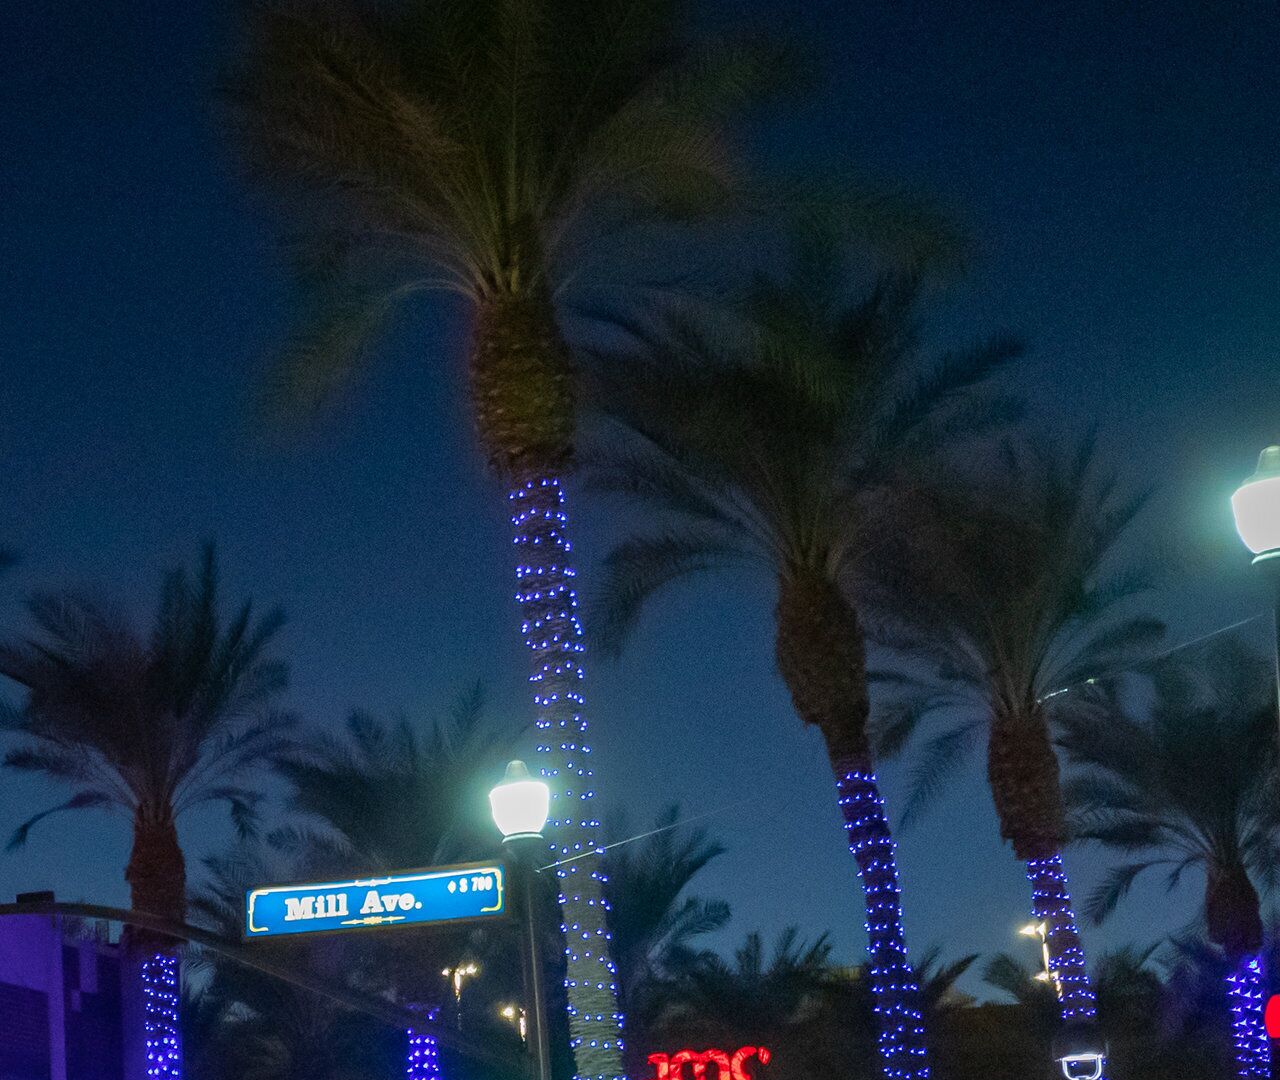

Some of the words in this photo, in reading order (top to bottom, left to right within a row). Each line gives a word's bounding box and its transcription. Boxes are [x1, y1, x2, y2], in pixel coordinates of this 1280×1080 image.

[284, 893, 349, 922] Mill
[360, 890, 423, 915] Ave.
[459, 878, 468, 892] S
[472, 876, 492, 892] 700
